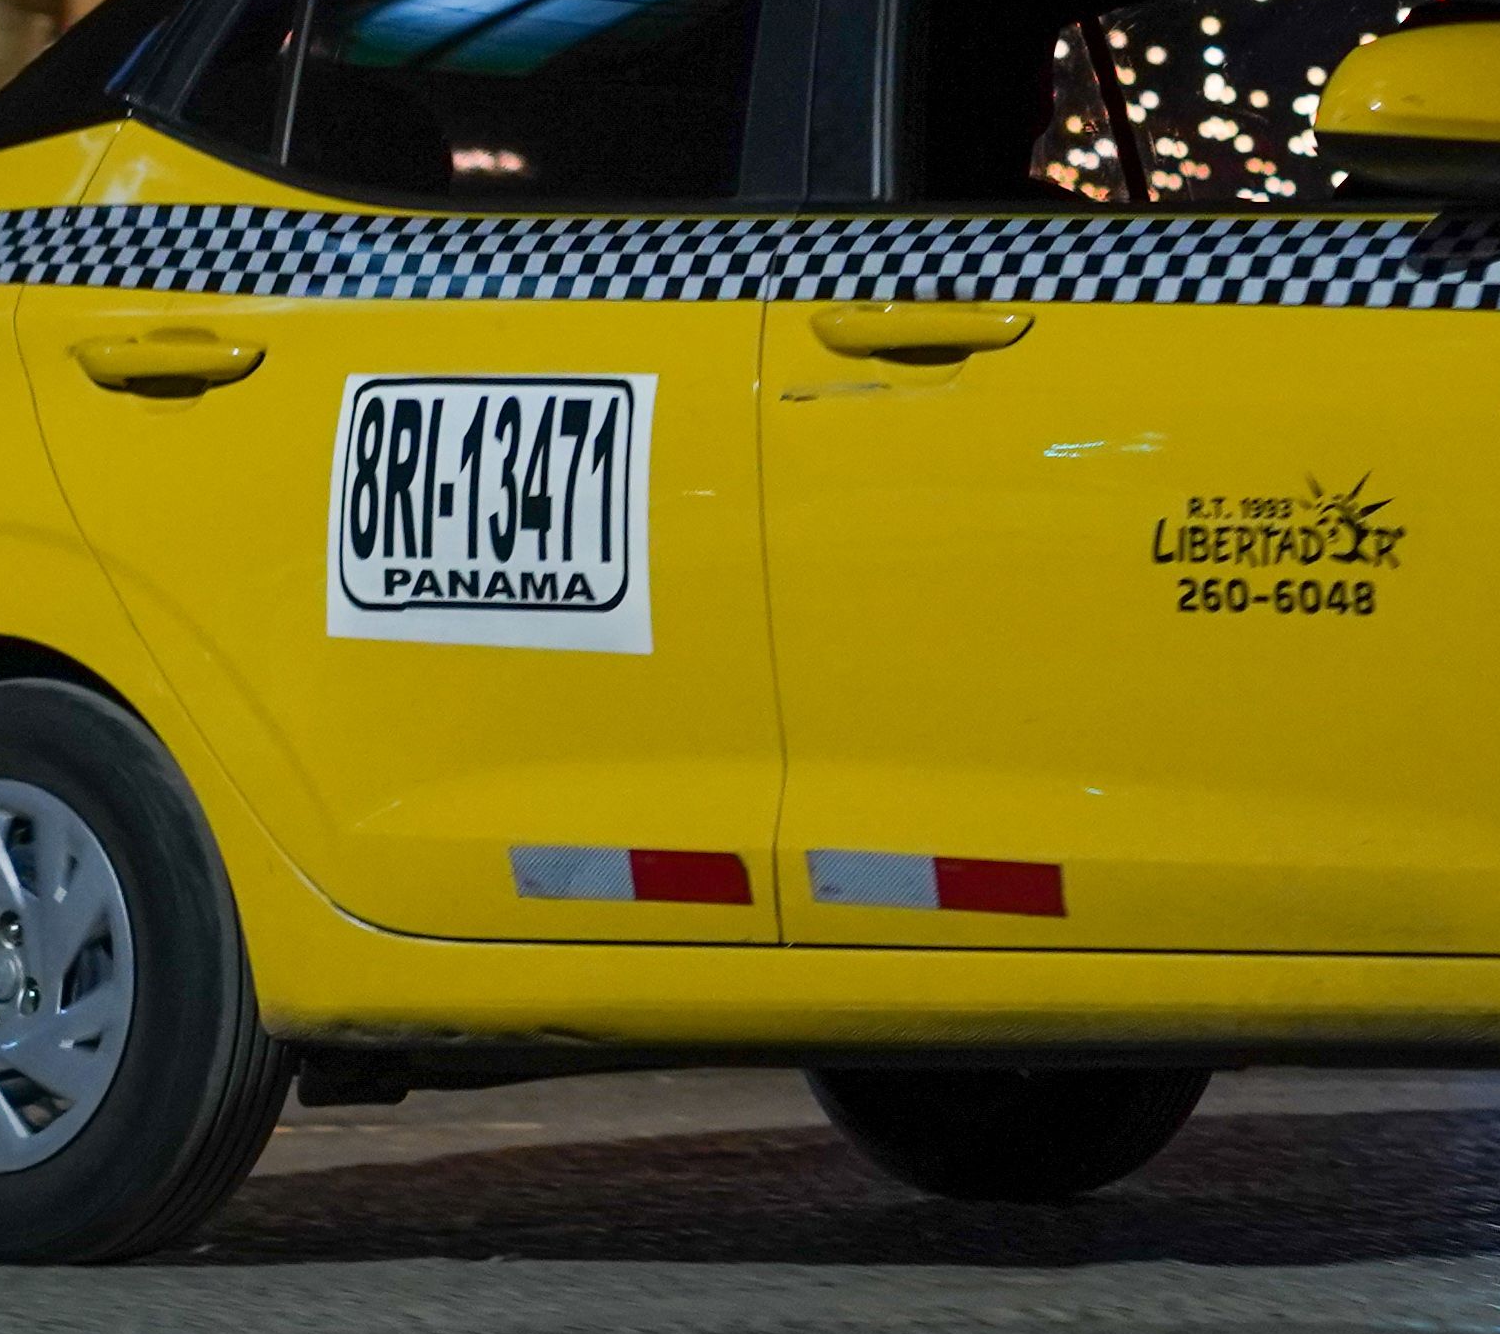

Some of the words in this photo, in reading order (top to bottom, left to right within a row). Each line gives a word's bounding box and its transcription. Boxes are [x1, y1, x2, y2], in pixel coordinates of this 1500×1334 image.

[350, 396, 619, 563] 8RI-13471
[383, 568, 596, 601] PANAMA
[1177, 577, 1375, 615] 260-6048
